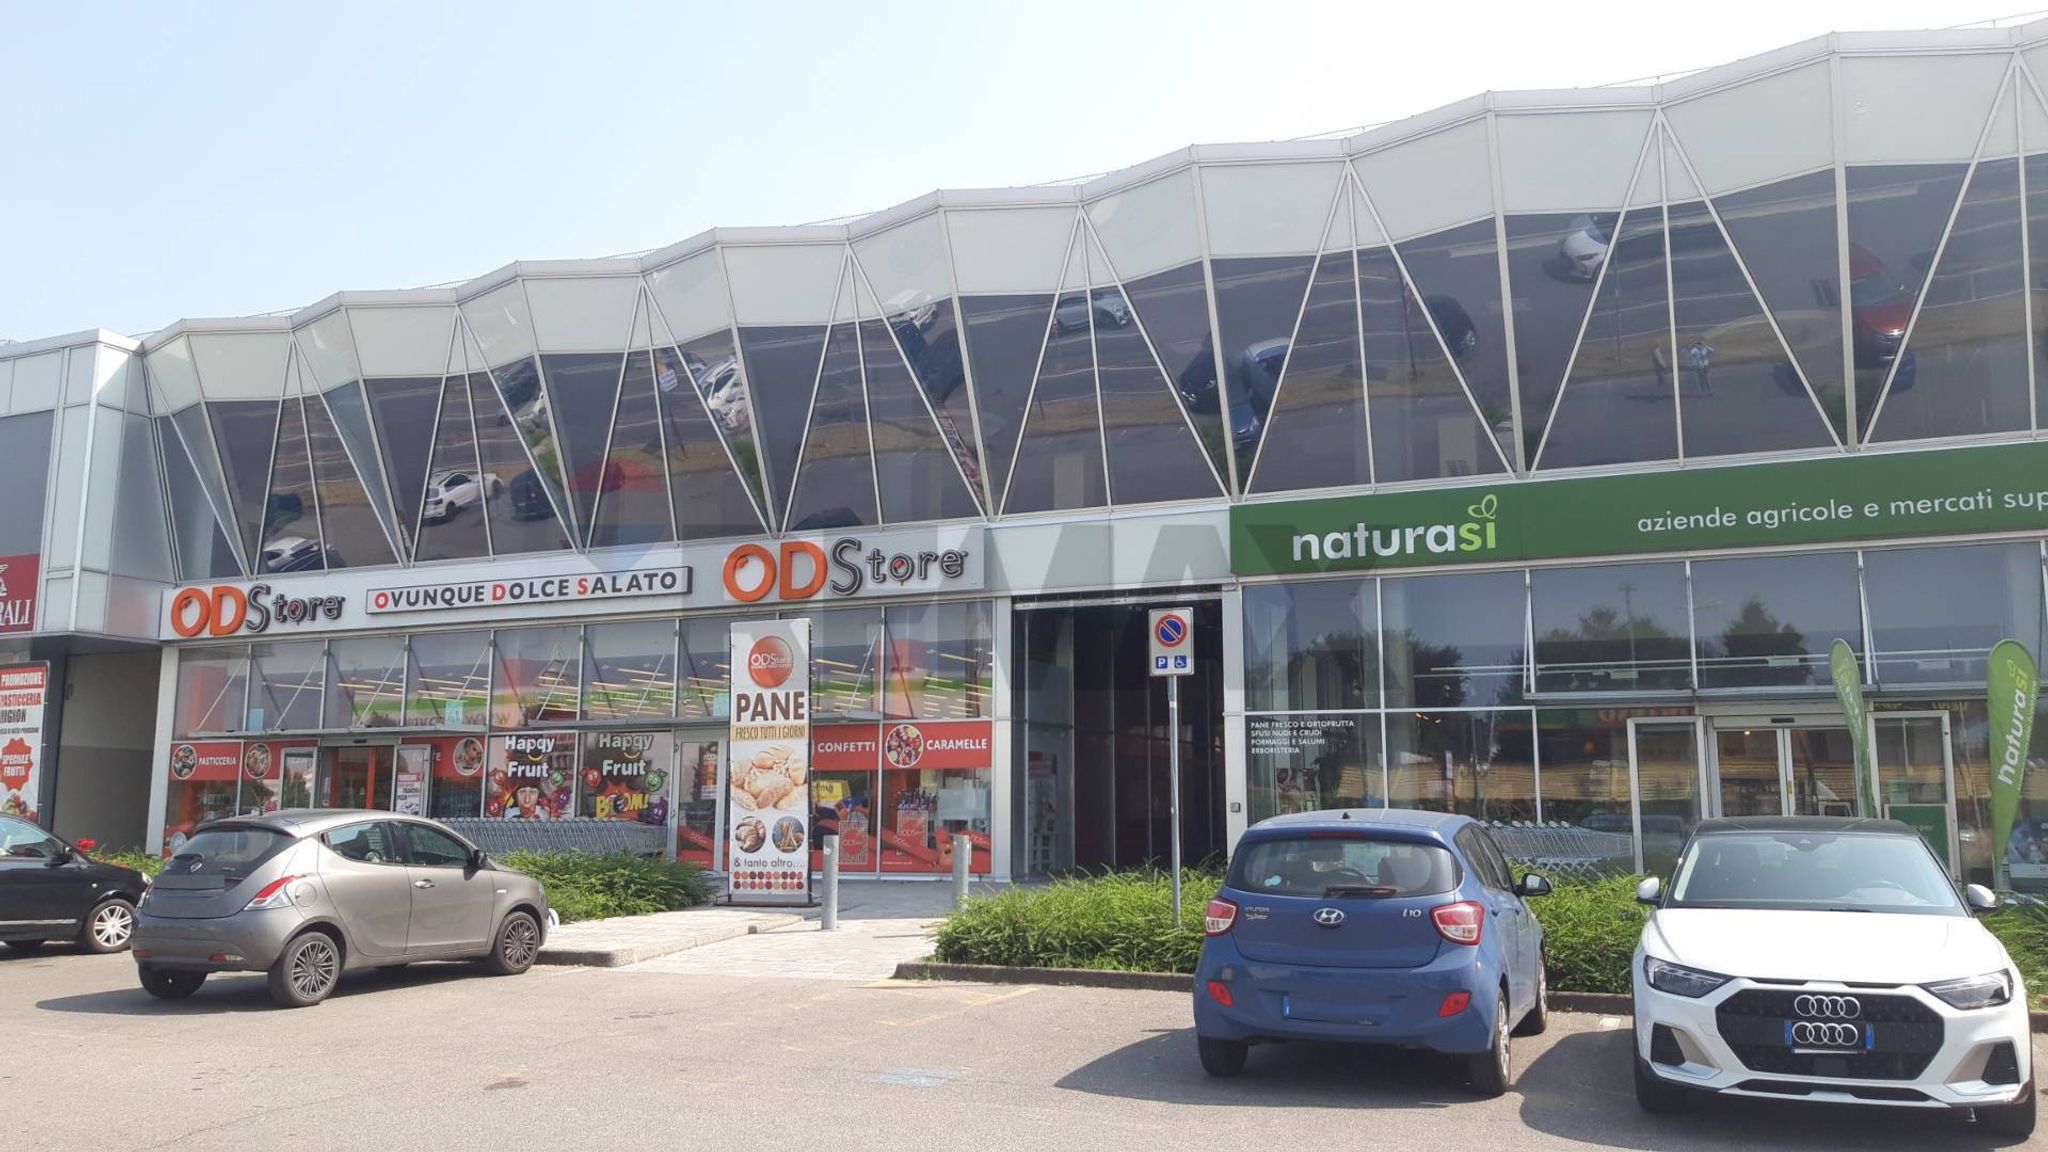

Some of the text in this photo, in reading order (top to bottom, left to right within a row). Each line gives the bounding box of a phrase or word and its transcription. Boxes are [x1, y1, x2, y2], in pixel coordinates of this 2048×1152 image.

[1637, 488, 2048, 532] aziende agricole e mercati sup
[374, 571, 677, 609] OVUNQUE DOLCE SALATO
[1158, 657, 1166, 668] P
[736, 691, 805, 722] PANE
[1250, 721, 1270, 729] PANE
[1306, 720, 1355, 728] ORTOFRUTTA
[735, 727, 759, 740] FRESCO
[760, 726, 777, 739] TUTTI
[782, 725, 806, 739] GIORNI
[817, 741, 876, 753] CONFETTI
[926, 738, 988, 751] CARAMELLE
[198, 757, 237, 766] PASTICCERIA
[602, 760, 646, 776] Fruit
[507, 761, 549, 777] Fruit
[744, 858, 768, 868] tanto
